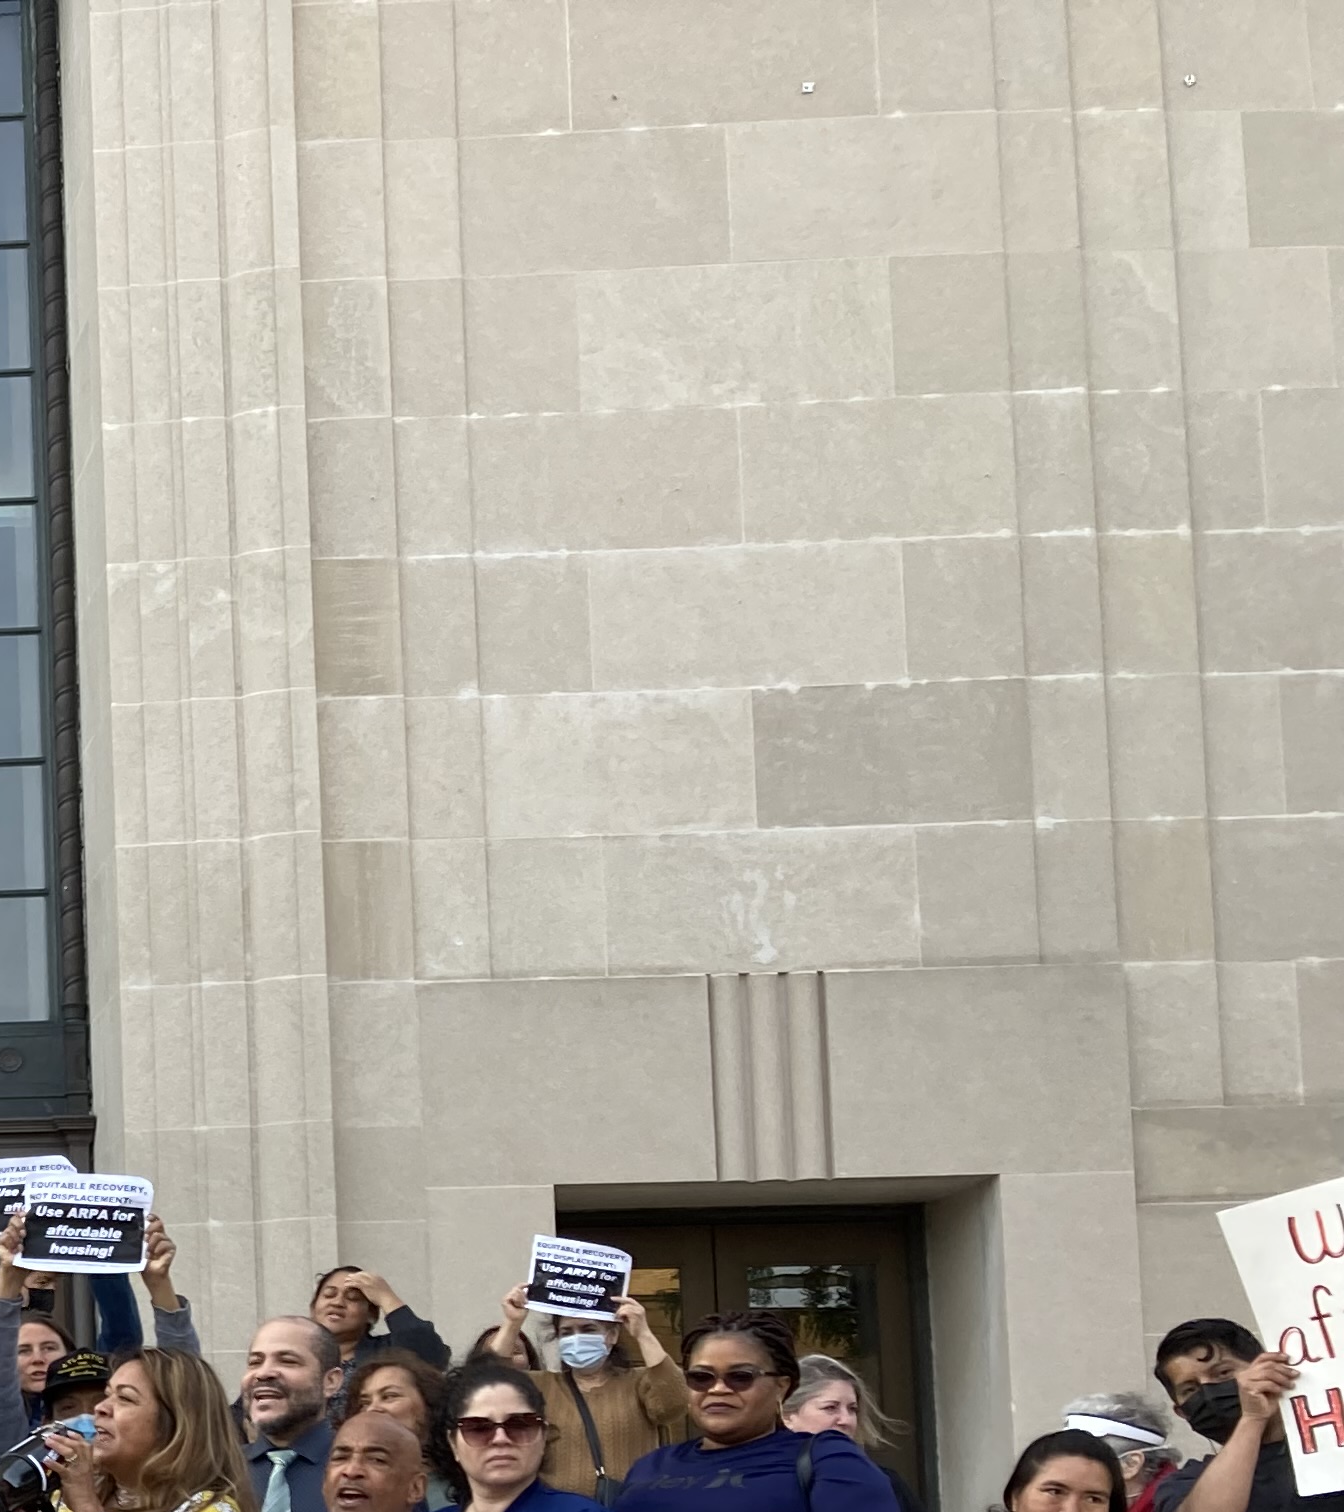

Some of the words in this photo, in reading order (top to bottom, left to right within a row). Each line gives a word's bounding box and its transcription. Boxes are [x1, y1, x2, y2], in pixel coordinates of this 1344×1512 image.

[31, 1181, 87, 1190] EQUITABLE
[35, 1205, 64, 1218] Use
[66, 1207, 109, 1221] ARPA
[112, 1210, 136, 1222] for
[45, 1225, 123, 1240] affordable
[49, 1243, 115, 1259] housing!
[537, 1242, 580, 1254] EQUITABLE
[541, 1262, 563, 1273] Use
[563, 1267, 597, 1279] ARPA
[599, 1272, 618, 1281] for
[546, 1279, 606, 1294] affordable
[548, 1291, 599, 1308] housing!
